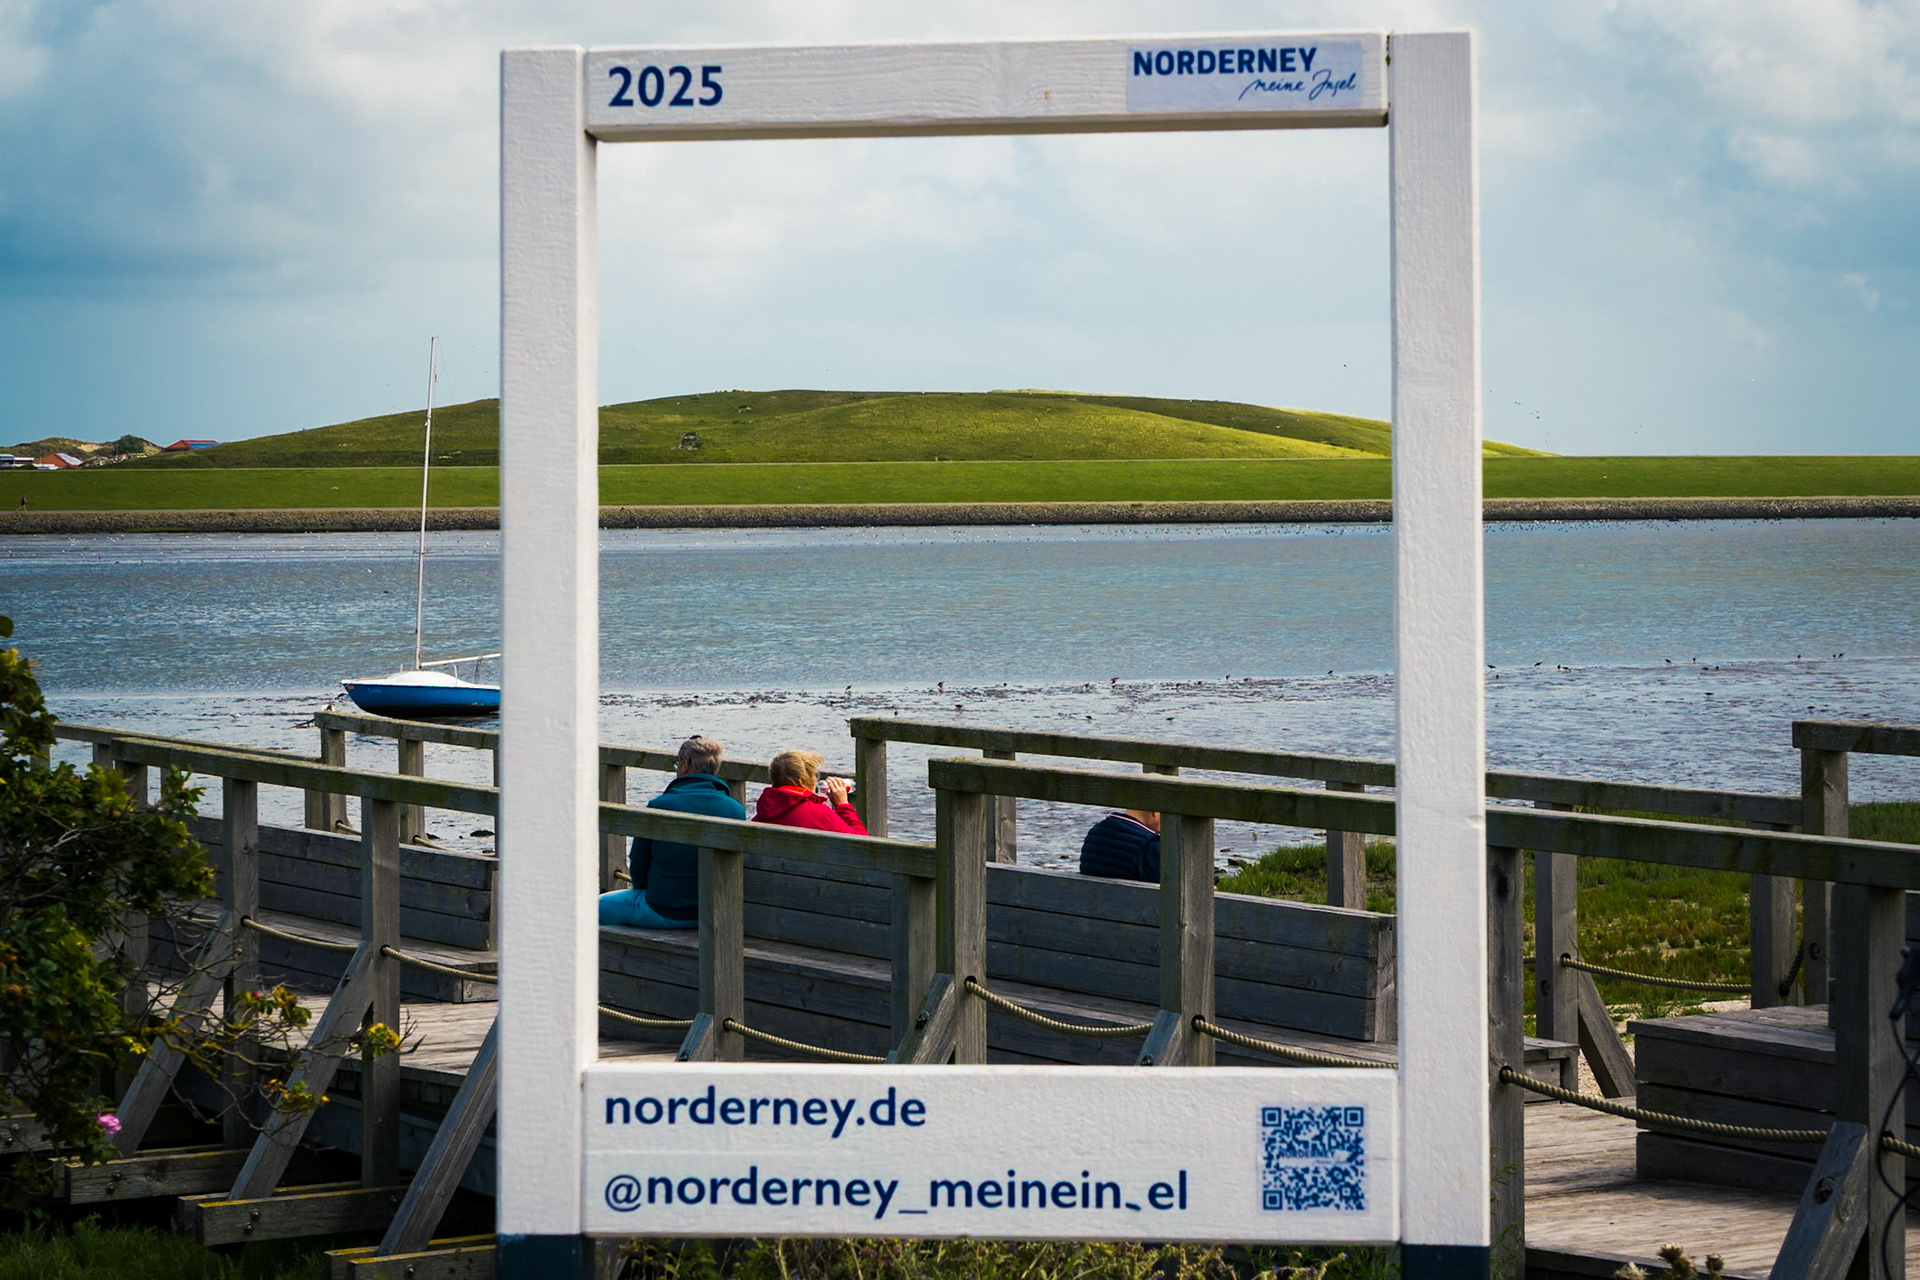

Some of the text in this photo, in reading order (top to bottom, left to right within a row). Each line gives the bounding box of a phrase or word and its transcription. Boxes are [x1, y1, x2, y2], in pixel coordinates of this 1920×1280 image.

[1134, 47, 1317, 76] NORDERNEY
[608, 65, 723, 107] 2025
[1238, 78, 1305, 101] meine
[605, 1085, 926, 1139] norderney.de
[604, 1165, 1187, 1220] @norderney_meineinel
